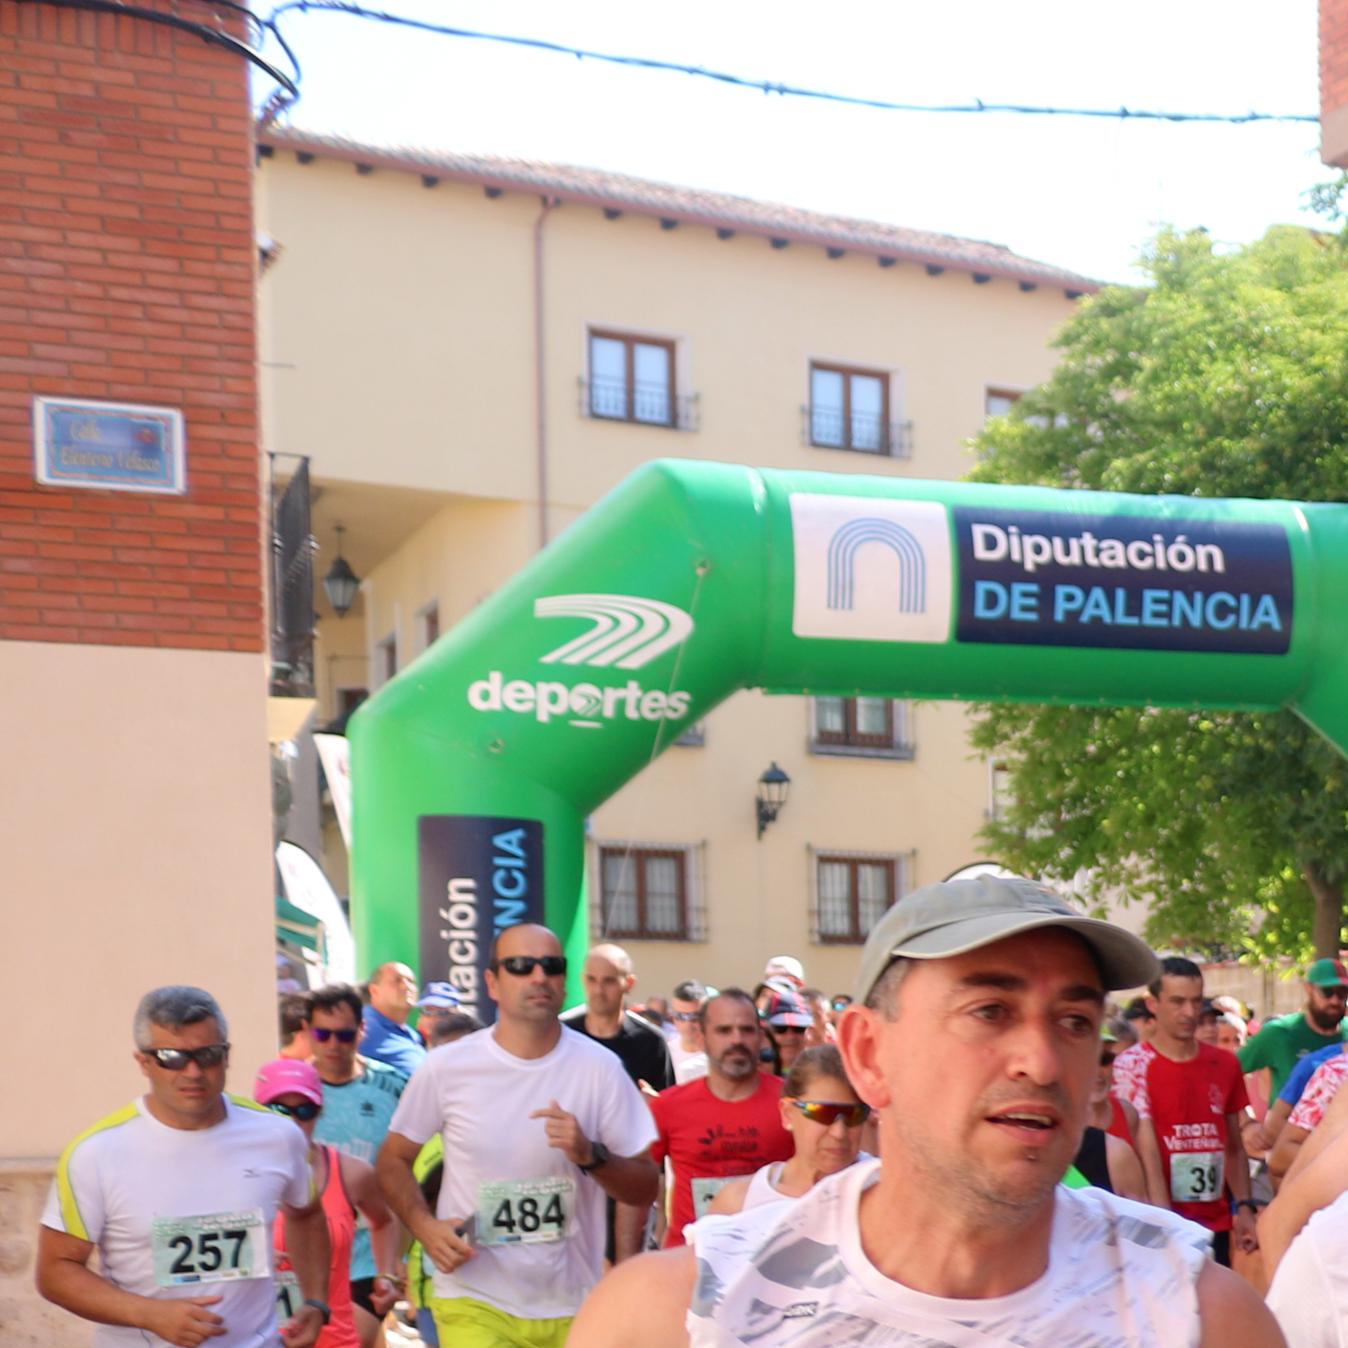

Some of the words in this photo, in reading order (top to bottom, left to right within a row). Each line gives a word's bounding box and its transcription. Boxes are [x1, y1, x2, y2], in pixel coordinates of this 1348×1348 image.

[971, 522, 1225, 573] Diputación
[973, 580, 1040, 621] DE
[1053, 584, 1283, 631] PALENCIA
[467, 671, 692, 722] deportes
[1172, 1123, 1218, 1138] TROTA
[1190, 1167, 1217, 1193] 39
[492, 1194, 565, 1233] 484
[168, 1229, 247, 1275] 257
